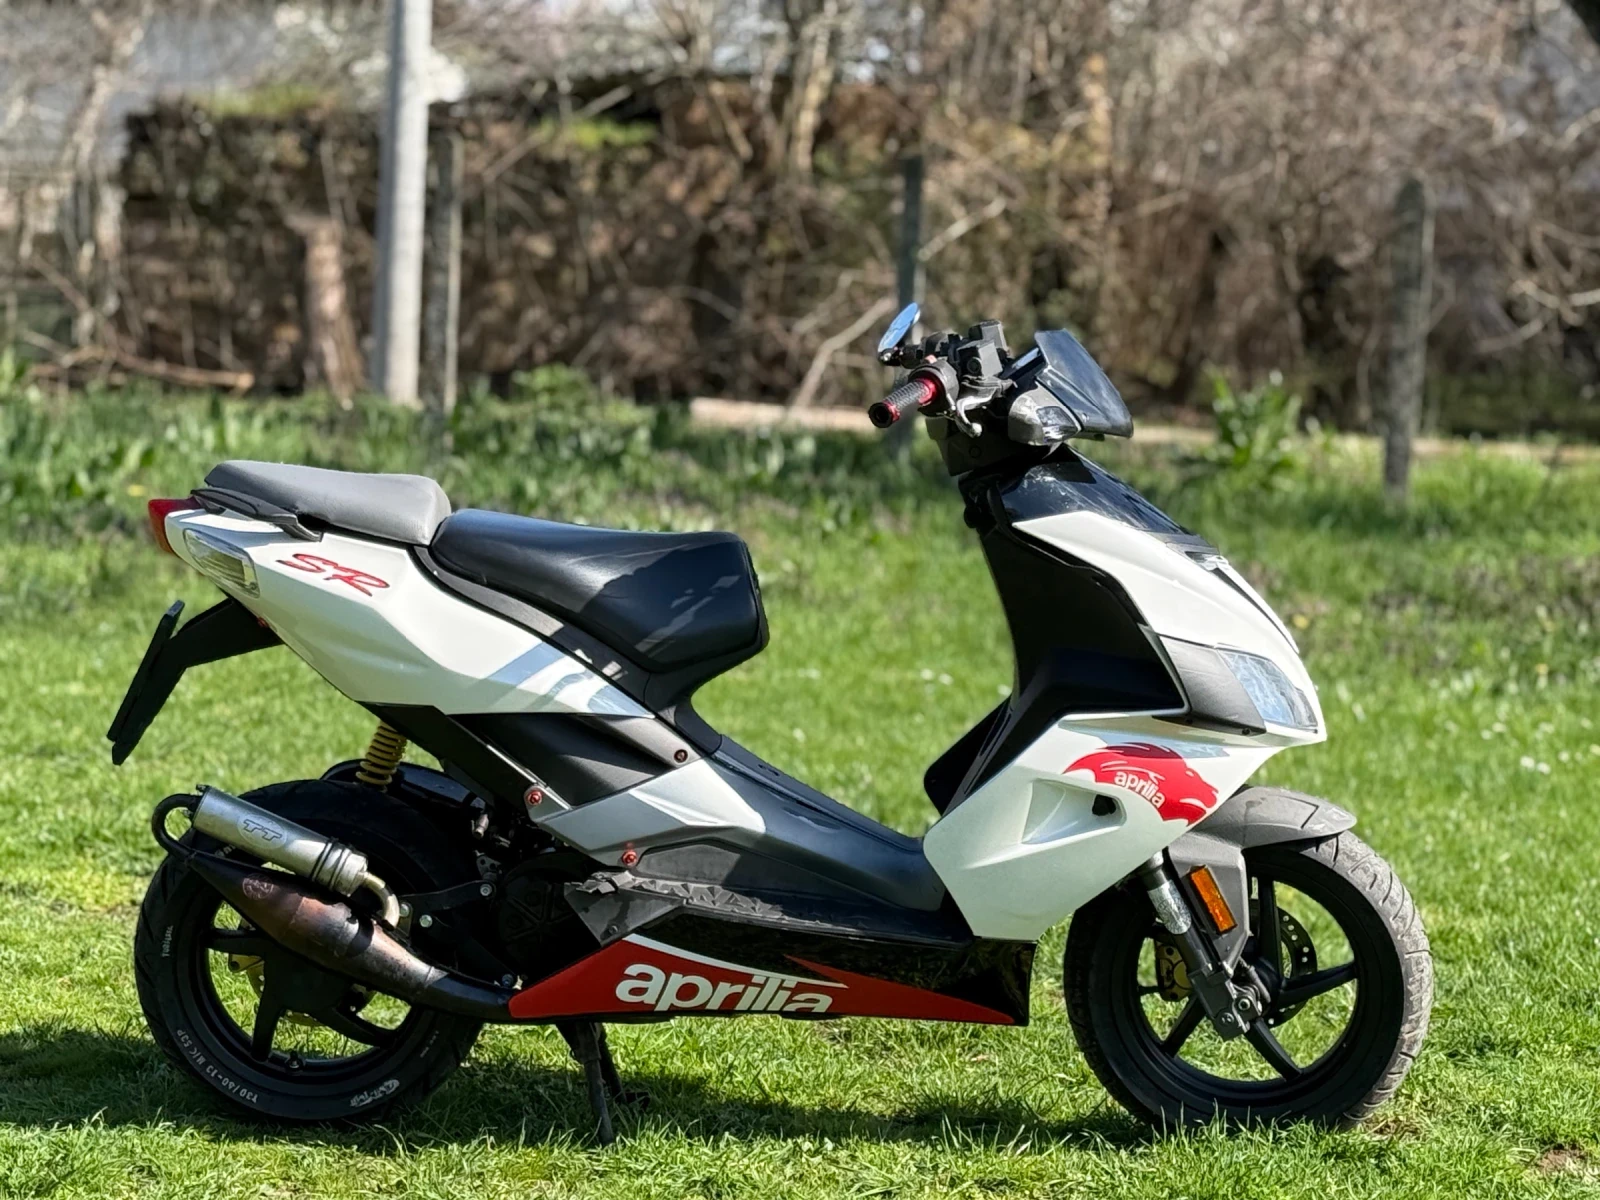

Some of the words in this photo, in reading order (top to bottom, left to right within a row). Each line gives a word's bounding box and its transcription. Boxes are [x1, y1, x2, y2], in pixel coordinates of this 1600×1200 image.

[275, 553, 390, 597] SR
[1114, 771, 1166, 809] aprilia
[243, 818, 283, 841] TT
[615, 963, 834, 1013] aprilia
